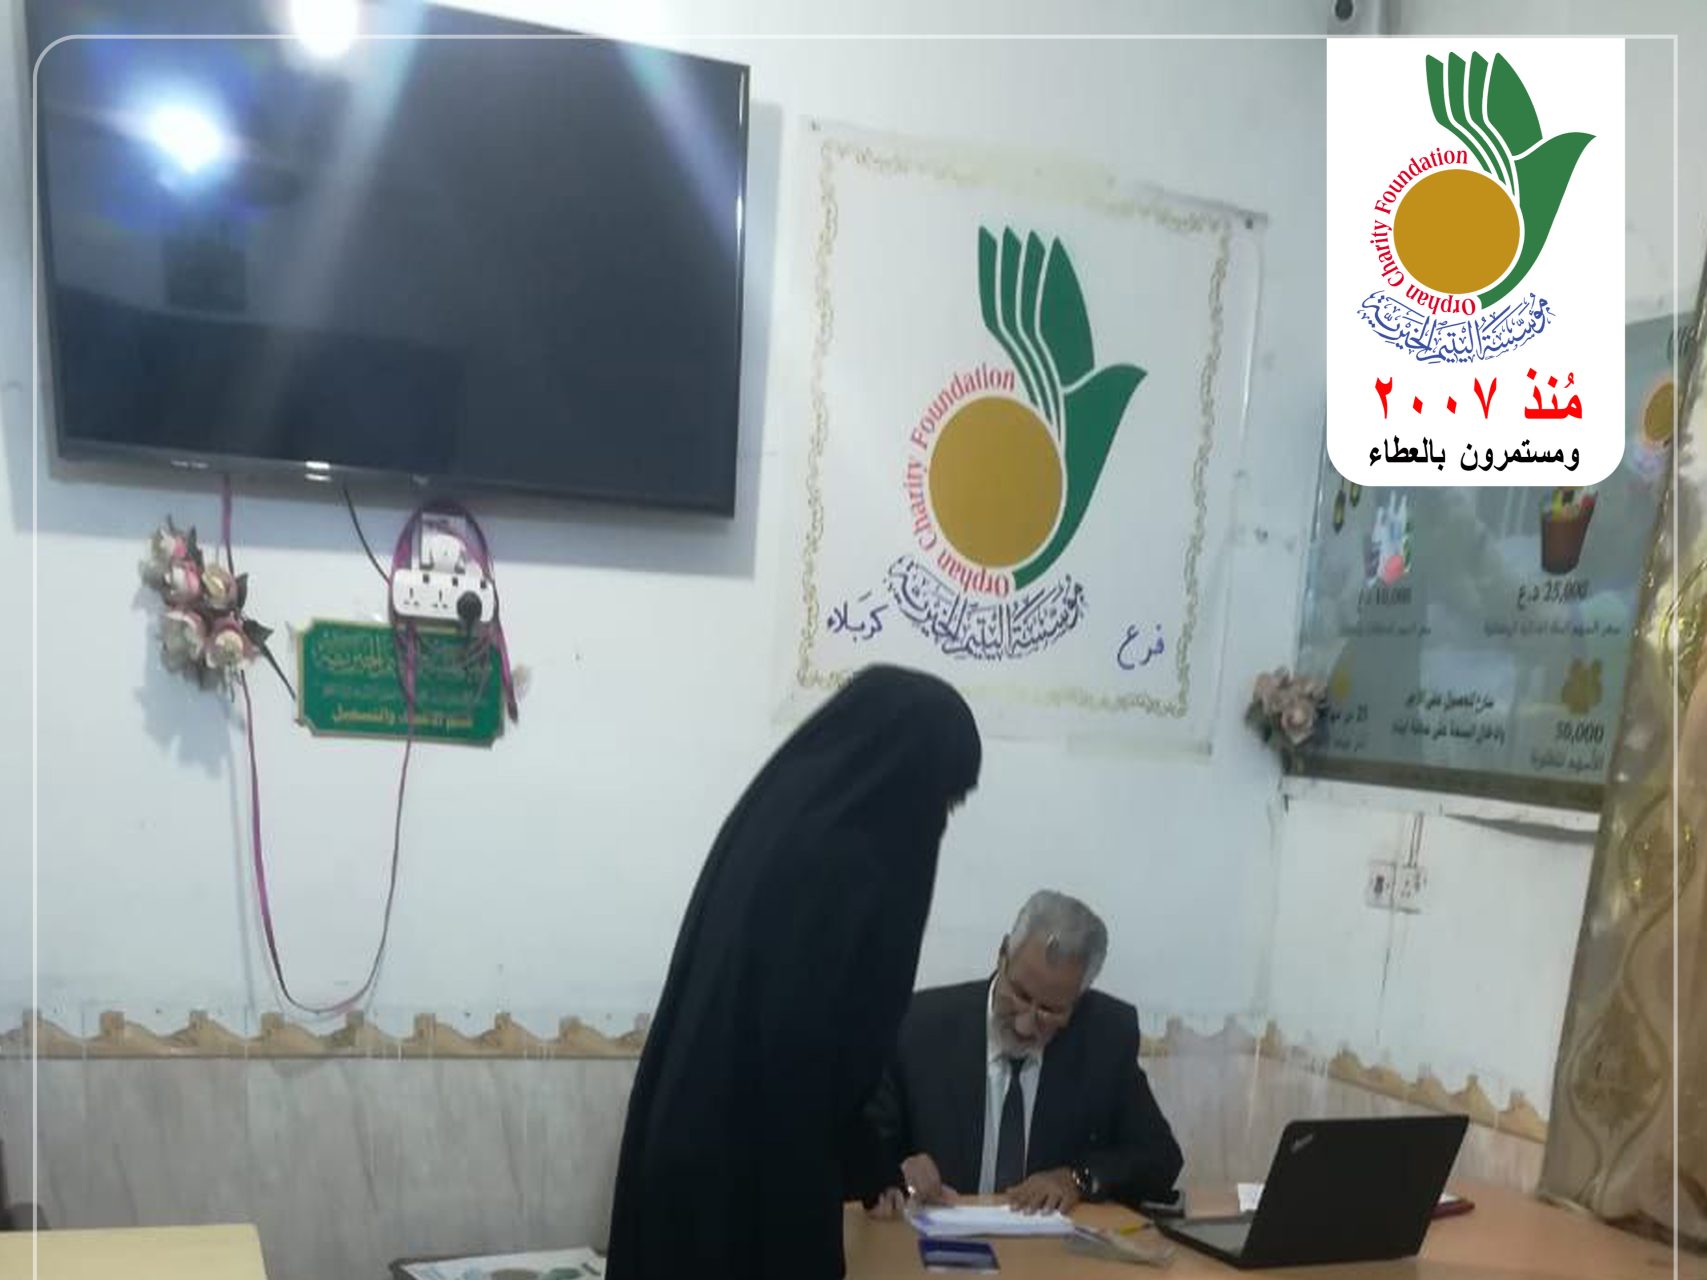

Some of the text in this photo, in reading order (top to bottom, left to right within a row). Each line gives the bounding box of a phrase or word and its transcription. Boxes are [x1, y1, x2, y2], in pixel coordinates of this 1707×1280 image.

[904, 362, 1015, 598] Orphan Charity Foundation
[1116, 624, 1164, 670] فرع
